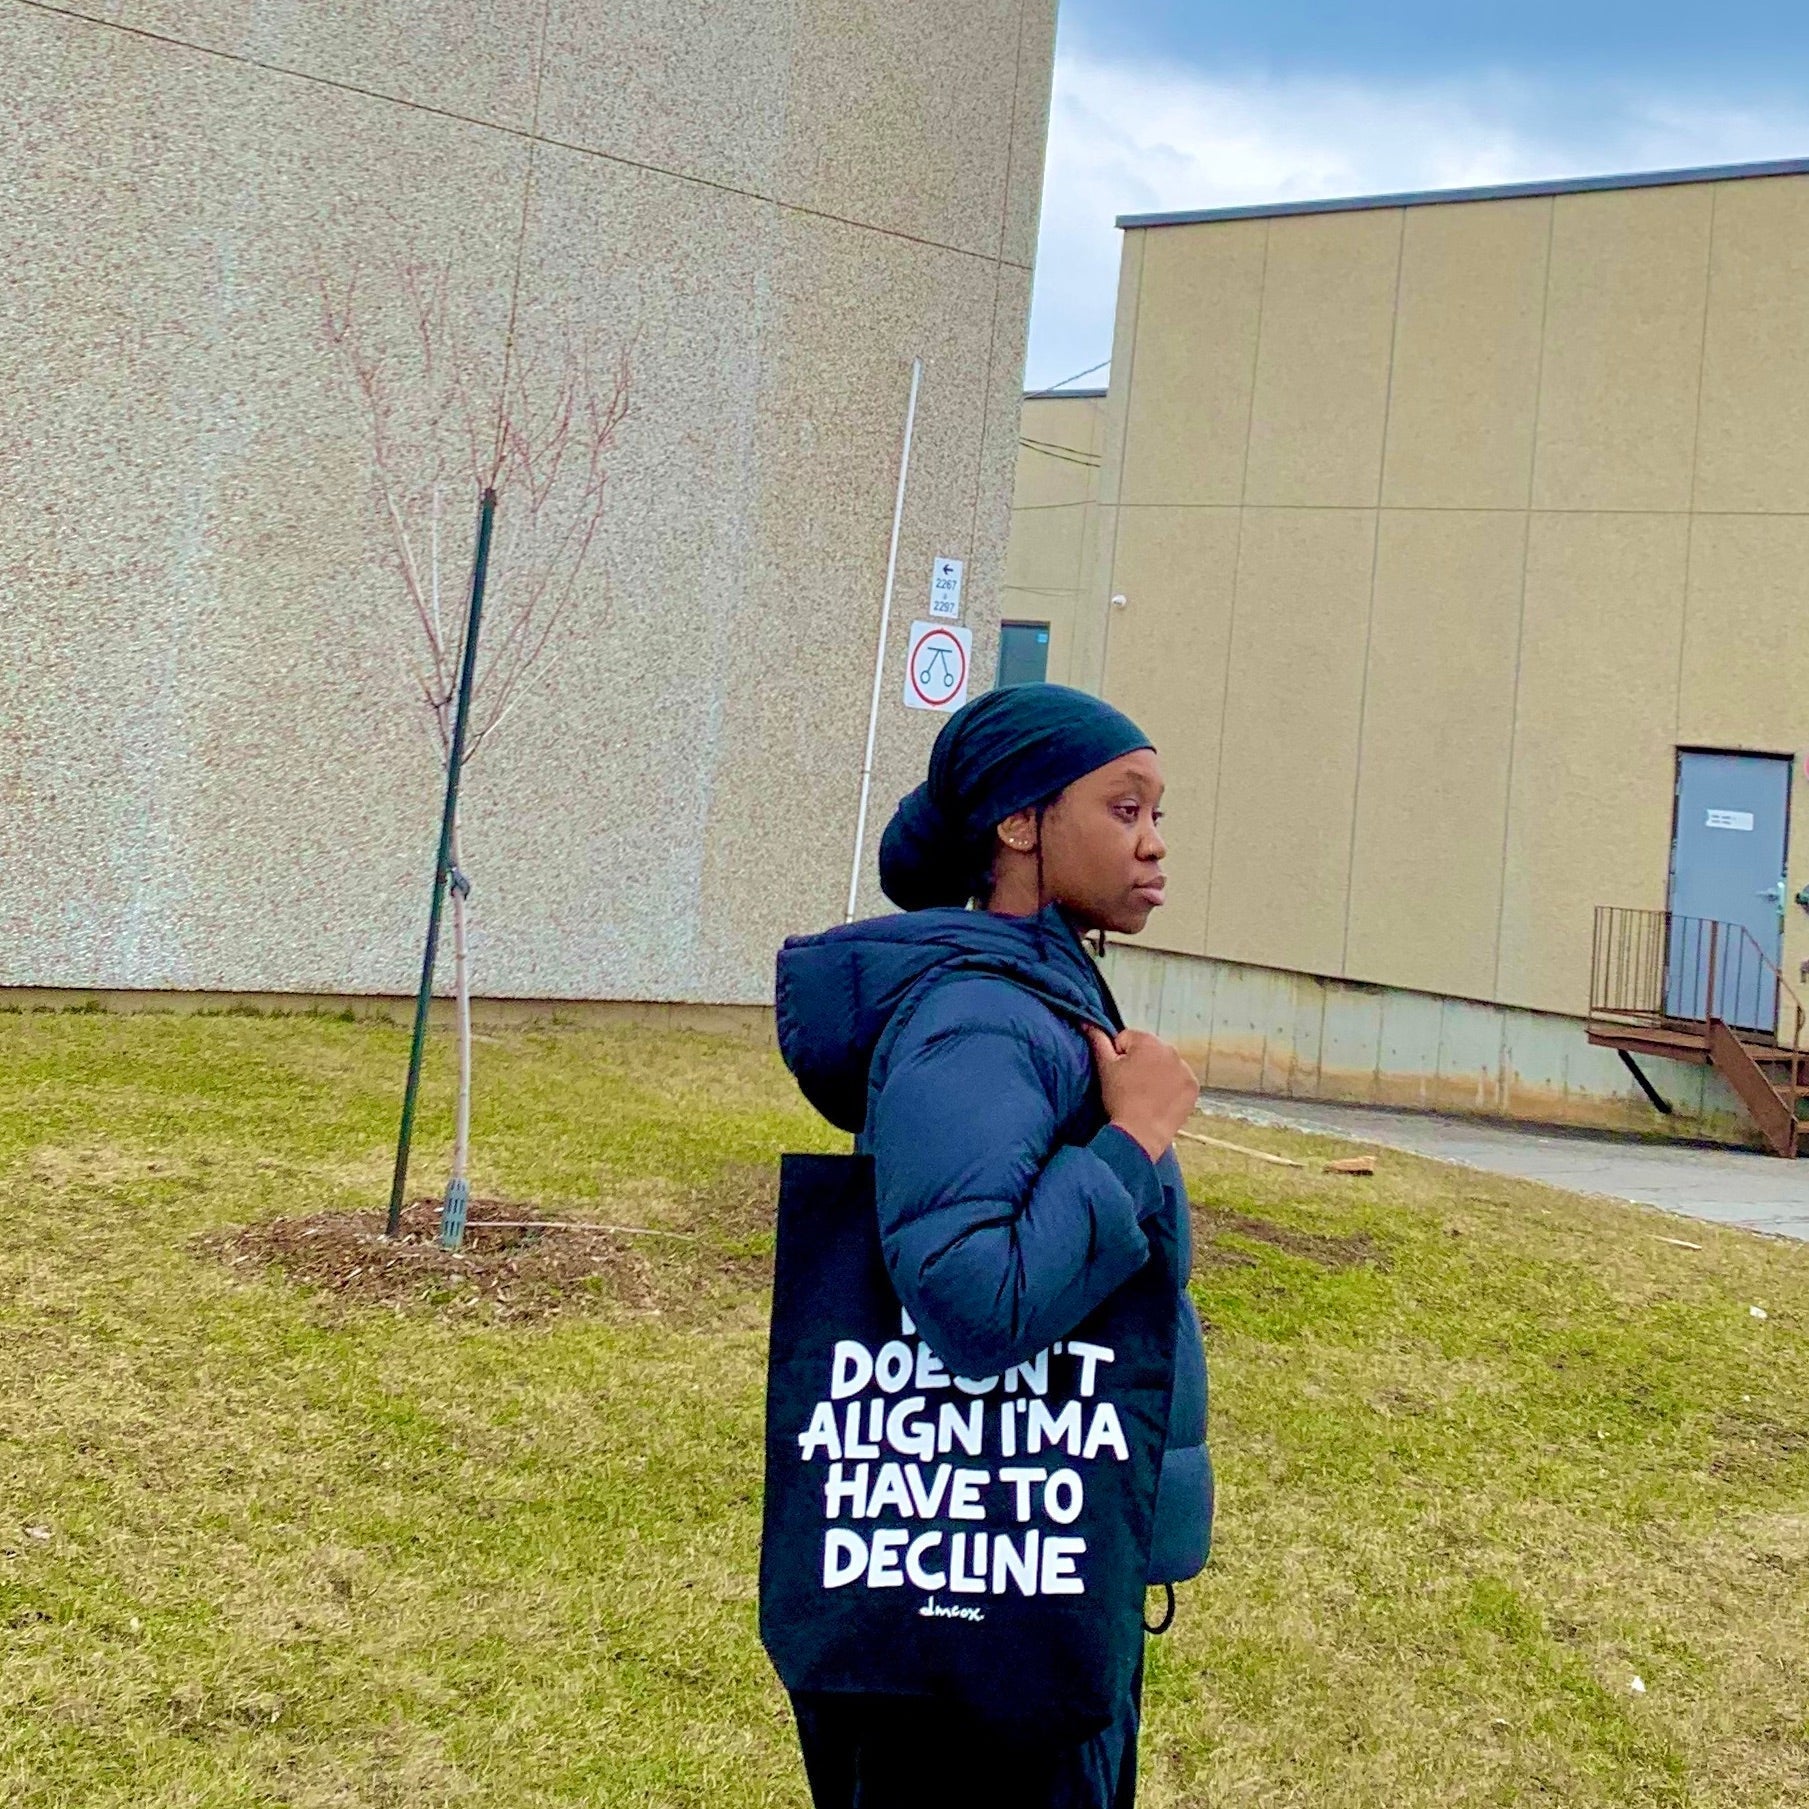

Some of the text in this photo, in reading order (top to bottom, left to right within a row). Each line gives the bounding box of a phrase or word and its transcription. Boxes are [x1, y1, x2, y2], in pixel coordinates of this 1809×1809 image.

[935, 577, 957, 590] 2267
[798, 1397, 984, 1462] ALIGN
[825, 1463, 1084, 1524] HAVE TO
[824, 1528, 1086, 1596] DECLINE
